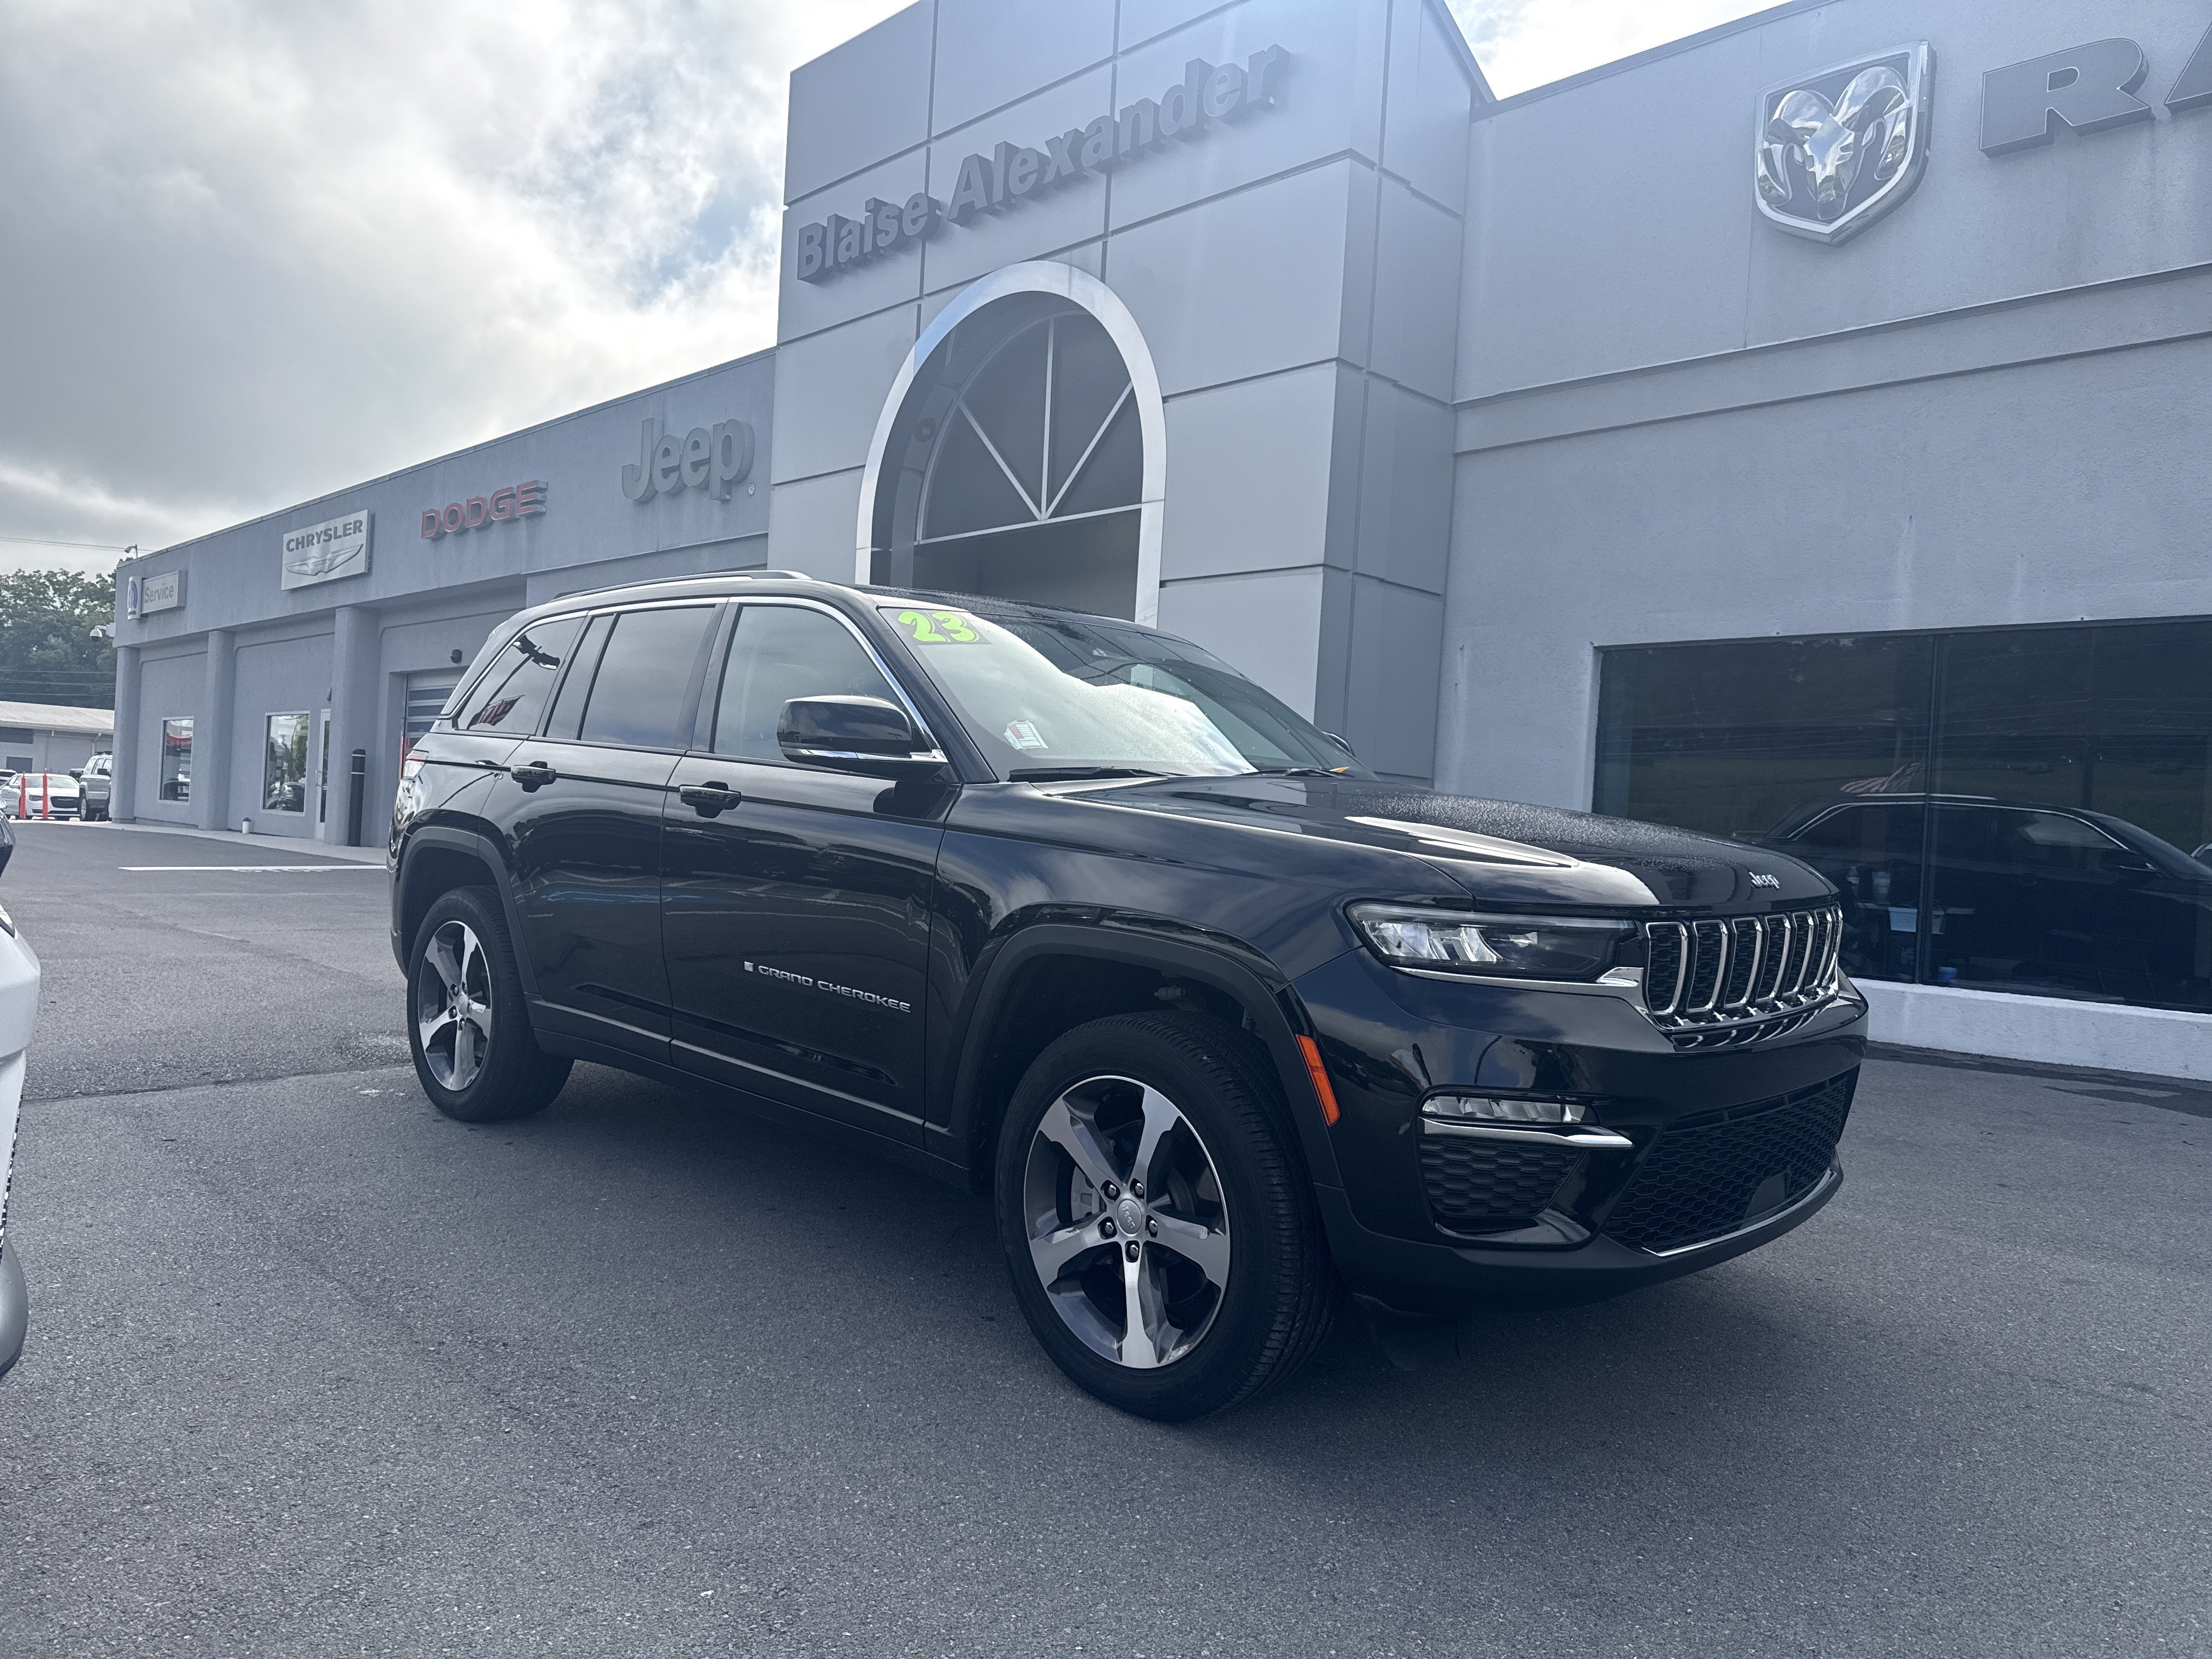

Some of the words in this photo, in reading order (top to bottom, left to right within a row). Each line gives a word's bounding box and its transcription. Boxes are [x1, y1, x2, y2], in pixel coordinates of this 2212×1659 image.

[797, 192, 940, 281] Blaise
[947, 44, 1289, 226] Alexander
[622, 417, 754, 503] Jeep
[421, 479, 548, 540] DODGE
[286, 520, 363, 552] CHRYSLER
[144, 583, 174, 603] Service
[898, 611, 980, 642] 23
[1748, 871, 1780, 890] Jeep
[758, 965, 813, 987] GRAND
[817, 980, 911, 1013] CHEROKEE
[1122, 1204, 1136, 1229] Jeep
